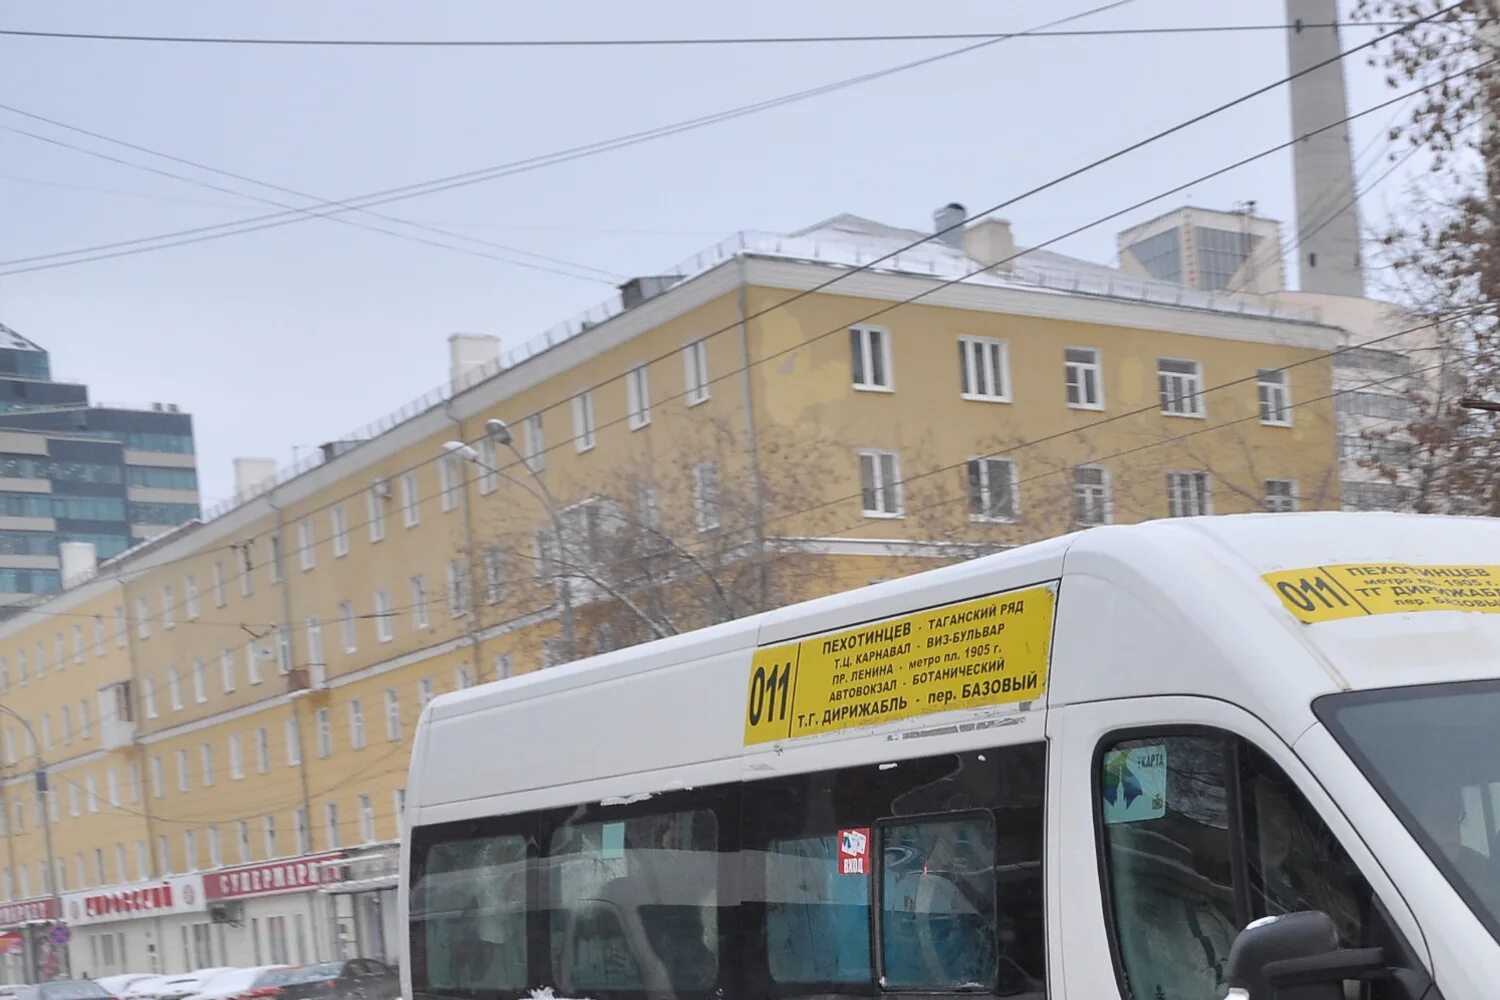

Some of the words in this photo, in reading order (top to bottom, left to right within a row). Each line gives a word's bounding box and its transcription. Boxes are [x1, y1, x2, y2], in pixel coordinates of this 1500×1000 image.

[1276, 576, 1349, 612] 011
[1346, 566, 1490, 577] ПЕХОТИНЦЕВ
[822, 621, 912, 655] ПЕХОТИНЦЕВ
[928, 603, 997, 630] ТАГАНСКИЙ
[1000, 600, 1024, 615] РЯД
[834, 656, 853, 669] Т.Ц.
[855, 642, 911, 665] КАРНАВАЛ
[926, 623, 1005, 648] ВИЗ-БУЛЬВАР
[829, 679, 897, 702] АВТОВОКЗАЛ
[912, 657, 1005, 686] БОТАНИЧЕСКИЙ
[832, 673, 848, 686] ПР.
[851, 663, 894, 681] ЛЕНИНА
[908, 655, 941, 670] метро
[943, 652, 960, 663] пл.
[965, 643, 991, 658] 1905
[993, 643, 1002, 654] г.
[749, 661, 791, 727] 011
[797, 712, 819, 728] Т.Г.
[821, 695, 908, 727] ДИРИЖАБЛЬ
[927, 690, 957, 705] пер.
[961, 670, 1038, 699] БАЗОВЫЙ
[843, 857, 864, 874] ВХОД
